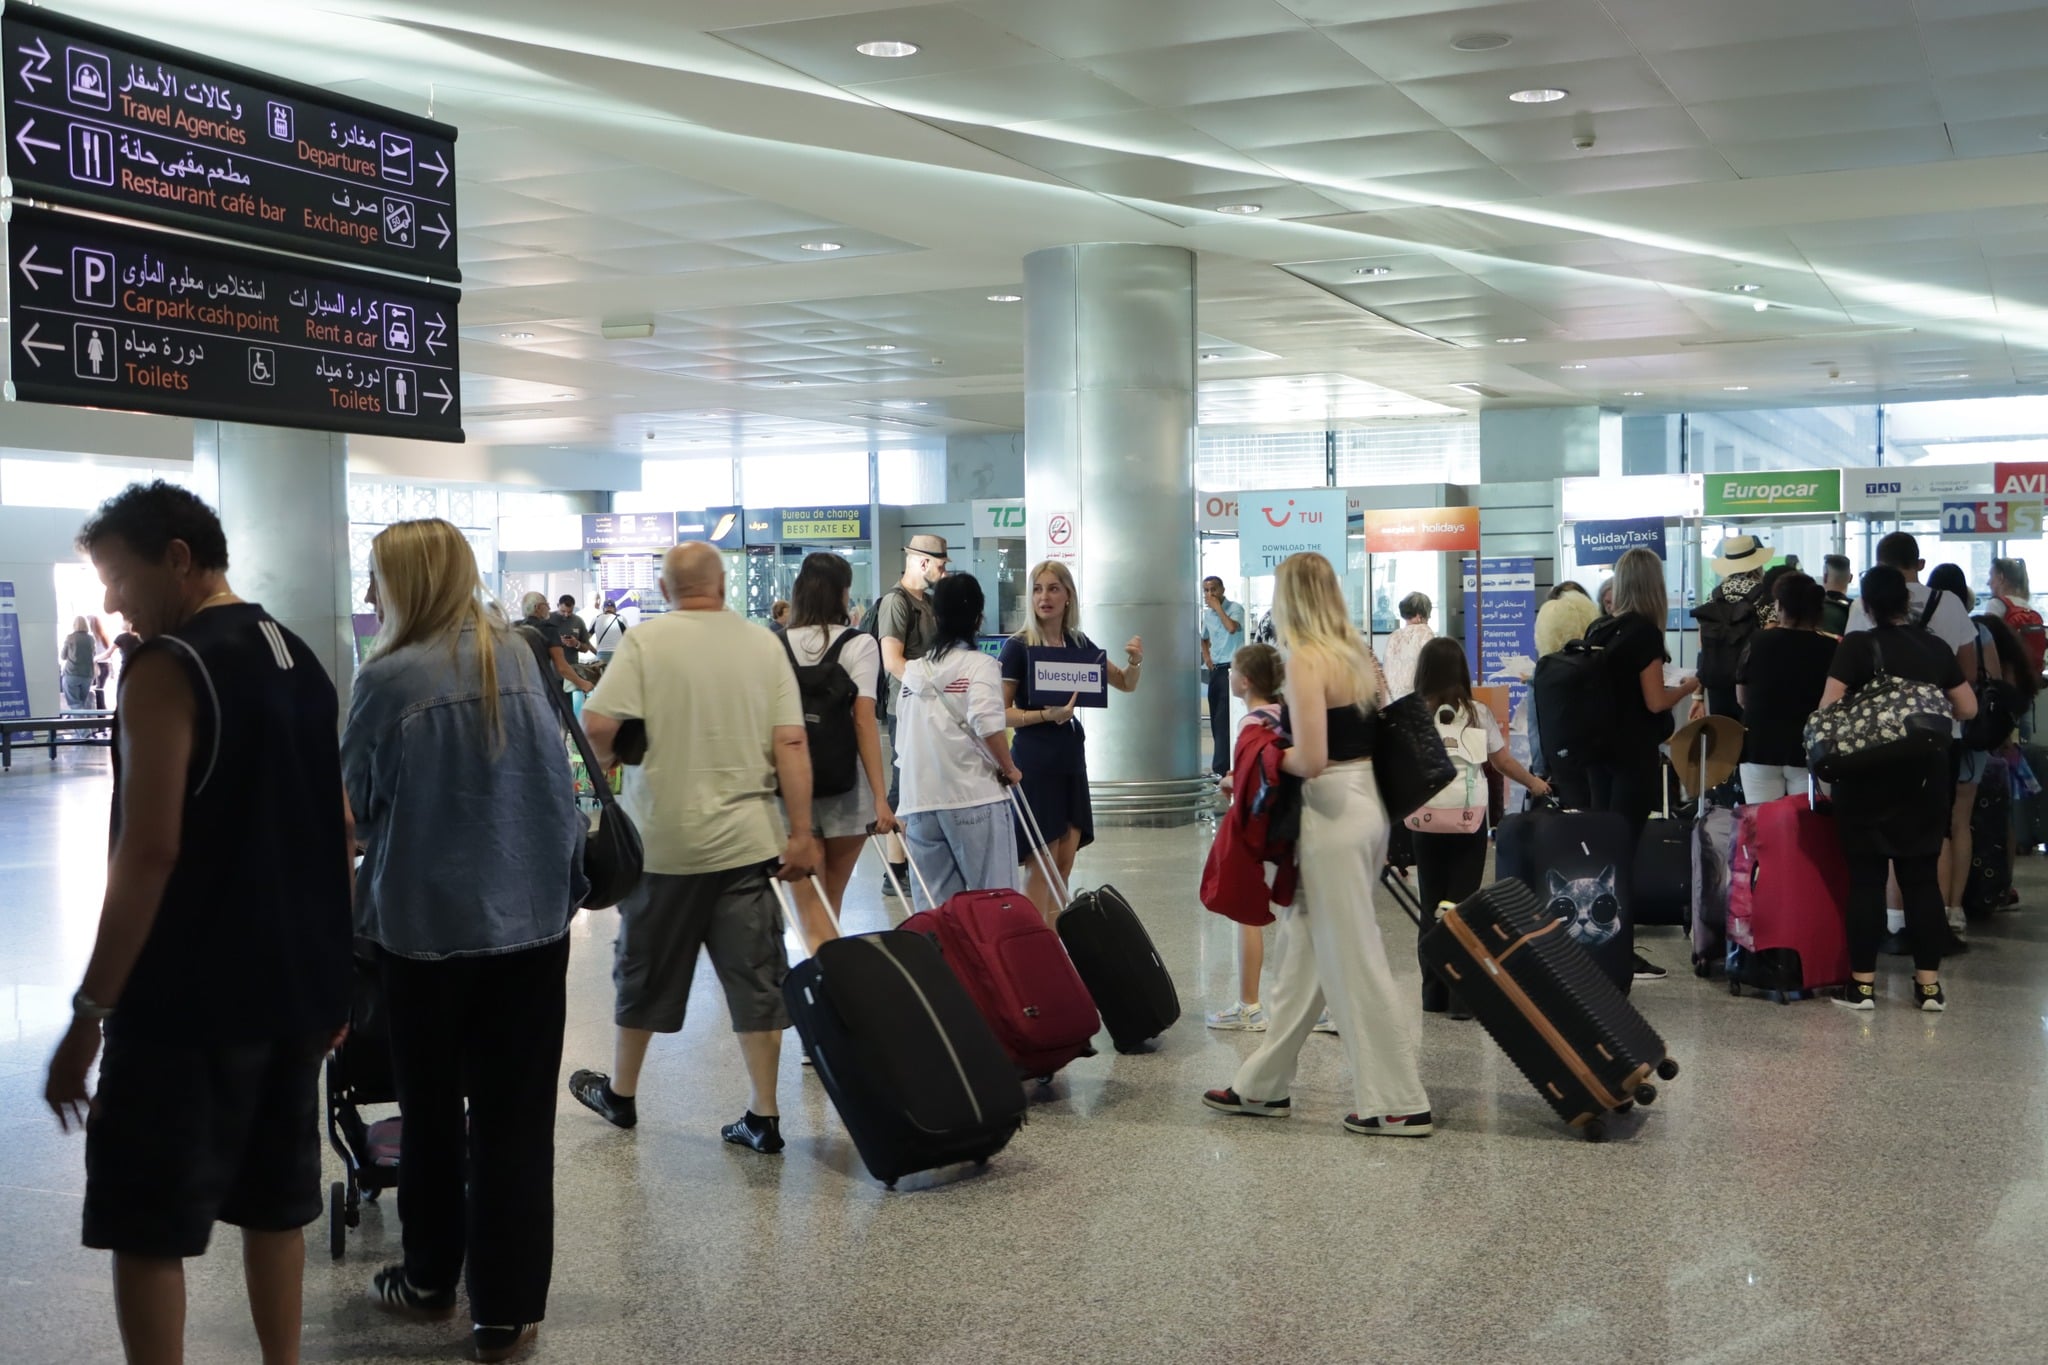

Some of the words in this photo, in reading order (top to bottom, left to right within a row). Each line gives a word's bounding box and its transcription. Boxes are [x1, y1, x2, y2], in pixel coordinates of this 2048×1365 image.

[119, 63, 178, 97] الأسفار
[184, 82, 242, 120] وكالات
[120, 94, 171, 127] Travel
[174, 108, 247, 145] Agencies
[330, 121, 376, 149] مغادرة
[120, 134, 159, 166] حانة
[298, 140, 377, 177] Departures
[160, 151, 205, 178] مقهى
[207, 158, 250, 187] مطعم
[121, 168, 217, 209] Restaurant
[221, 192, 255, 216] café
[259, 197, 287, 222] bar
[331, 188, 378, 216] صرف
[304, 208, 379, 244] Exchange
[85, 256, 106, 297] P
[122, 253, 164, 287] المأوى
[169, 265, 204, 296] معلوم
[208, 274, 265, 300] استخلاص
[288, 288, 345, 317] السيارات
[350, 297, 379, 325] كراء
[124, 328, 157, 359] مياه
[305, 319, 340, 345] Rent
[344, 329, 353, 345] a
[357, 331, 378, 348] car
[162, 336, 204, 366] دورة
[125, 362, 190, 391] Toilets
[316, 355, 342, 383] مياه
[346, 362, 380, 388] دورة
[329, 387, 381, 413] Toilets
[1722, 482, 1819, 503] Europcar
[1866, 482, 1901, 494] TAV
[2002, 474, 2048, 494] AVI
[782, 508, 811, 519] Bureau
[813, 507, 824, 519] de
[826, 507, 859, 521] change
[1299, 511, 1323, 524] TUI
[1421, 521, 1466, 534] holidays
[1943, 501, 2041, 533] mts
[786, 524, 809, 534] BEST
[813, 524, 838, 534] RATE
[842, 523, 856, 533] EX
[1581, 530, 1659, 545] HolidayTaxis
[1262, 544, 1305, 552] DOWNLOAD
[1307, 543, 1322, 551] THE
[1614, 543, 1631, 551] travel
[1483, 630, 1517, 638] Paiement
[1037, 669, 1088, 685] bluestyle
